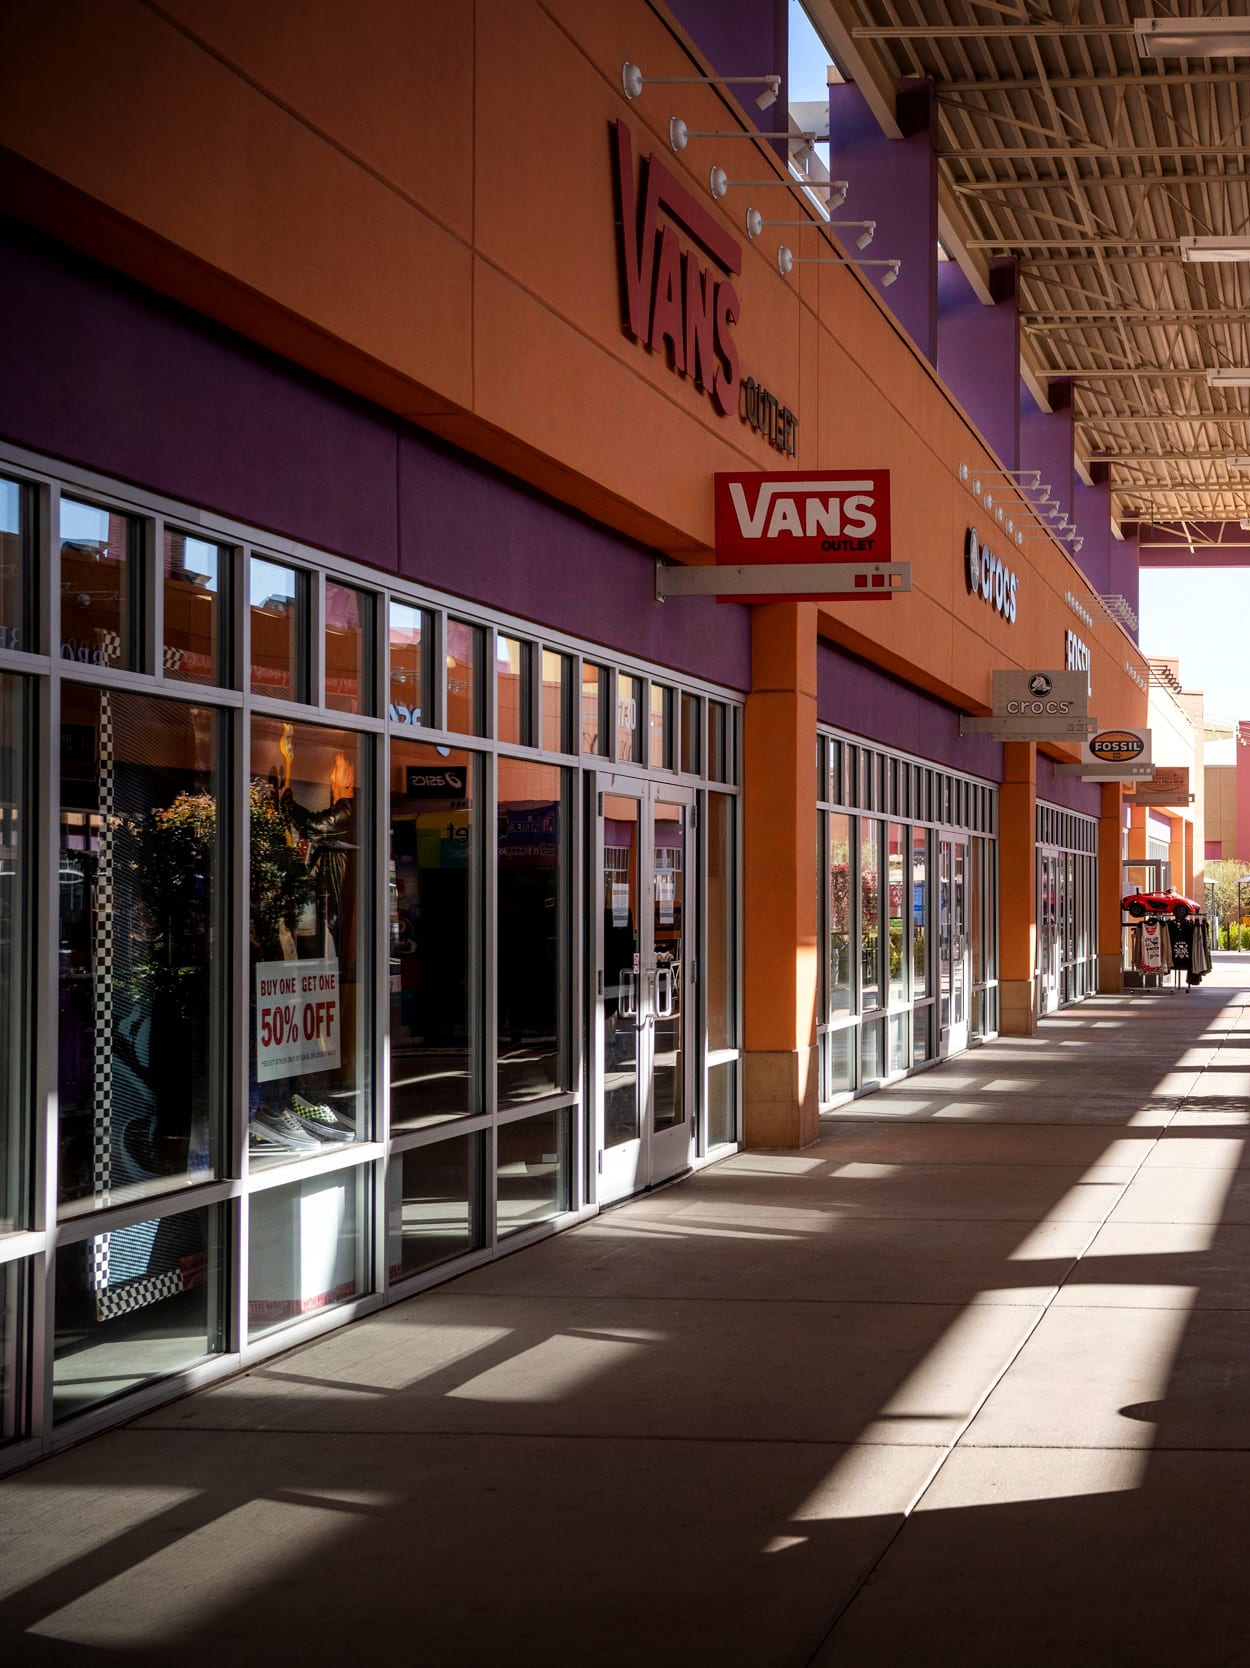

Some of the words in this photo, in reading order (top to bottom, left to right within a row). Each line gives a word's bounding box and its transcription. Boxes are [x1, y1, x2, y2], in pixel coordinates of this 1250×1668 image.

[615, 118, 742, 417] VANS
[744, 375, 798, 458] OUTLET
[728, 479, 877, 539] VANS
[821, 538, 875, 552] OUTLET
[981, 543, 1017, 624] crocs
[1007, 701, 1070, 714] crocs
[1095, 742, 1140, 751] FOSSIL
[261, 979, 278, 996] BUY
[279, 978, 296, 994] ONE
[302, 975, 317, 992] GET
[319, 974, 335, 991] ONE
[261, 1005, 298, 1047] 50%
[303, 1001, 336, 1041] OFF
